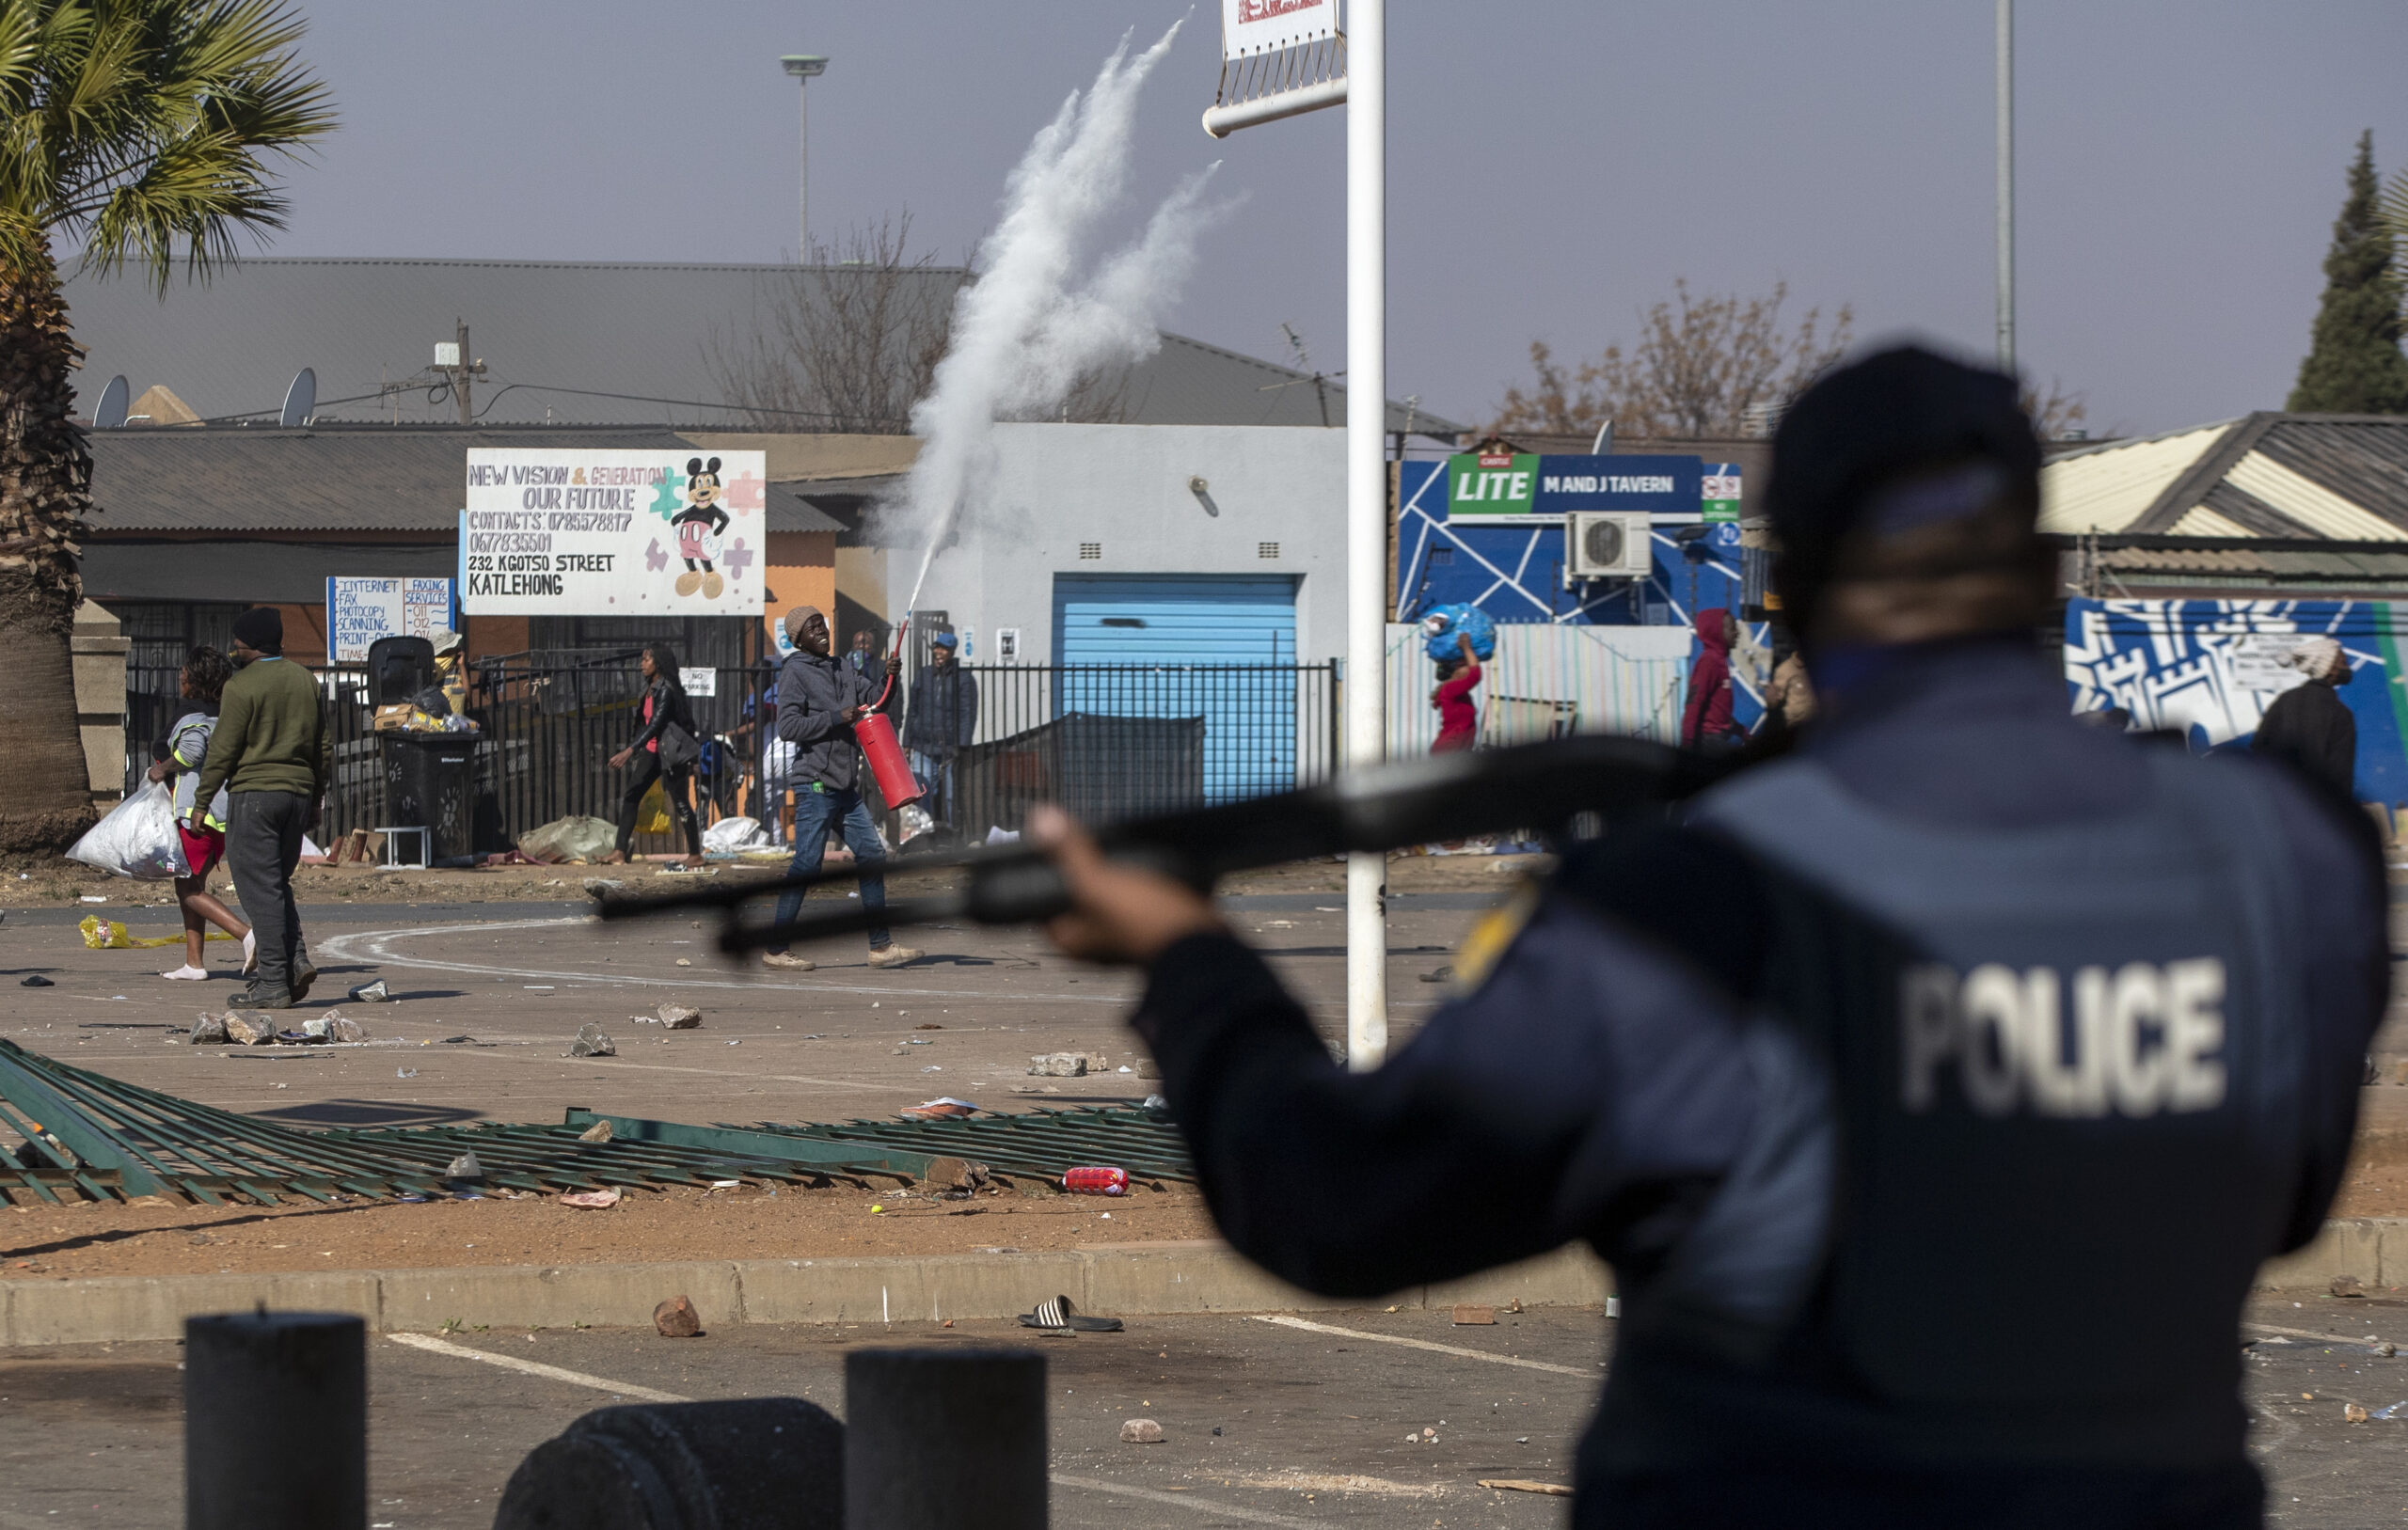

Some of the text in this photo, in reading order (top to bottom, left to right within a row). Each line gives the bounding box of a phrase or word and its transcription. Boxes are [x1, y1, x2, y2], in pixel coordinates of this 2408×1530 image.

[468, 465, 667, 486] NEW VISION & GENERATION
[1544, 476, 1674, 493] M AND J TAVERN
[1455, 472, 1529, 500] LITE
[523, 487, 635, 511] OUR FUTURE
[548, 512, 632, 532] 0785578817
[469, 532, 552, 553] 0677835501
[468, 554, 615, 572] 232 KGOTSO STREET
[339, 580, 399, 592] INTERNET
[413, 579, 444, 591] FAXING
[468, 573, 563, 595] KATLEHONG
[339, 593, 357, 606] FAX
[405, 592, 447, 605] SERVICES
[340, 606, 385, 618] PHOTOCOPY
[339, 618, 388, 631] SCANNING
[1898, 955, 2229, 1119] POLICE
